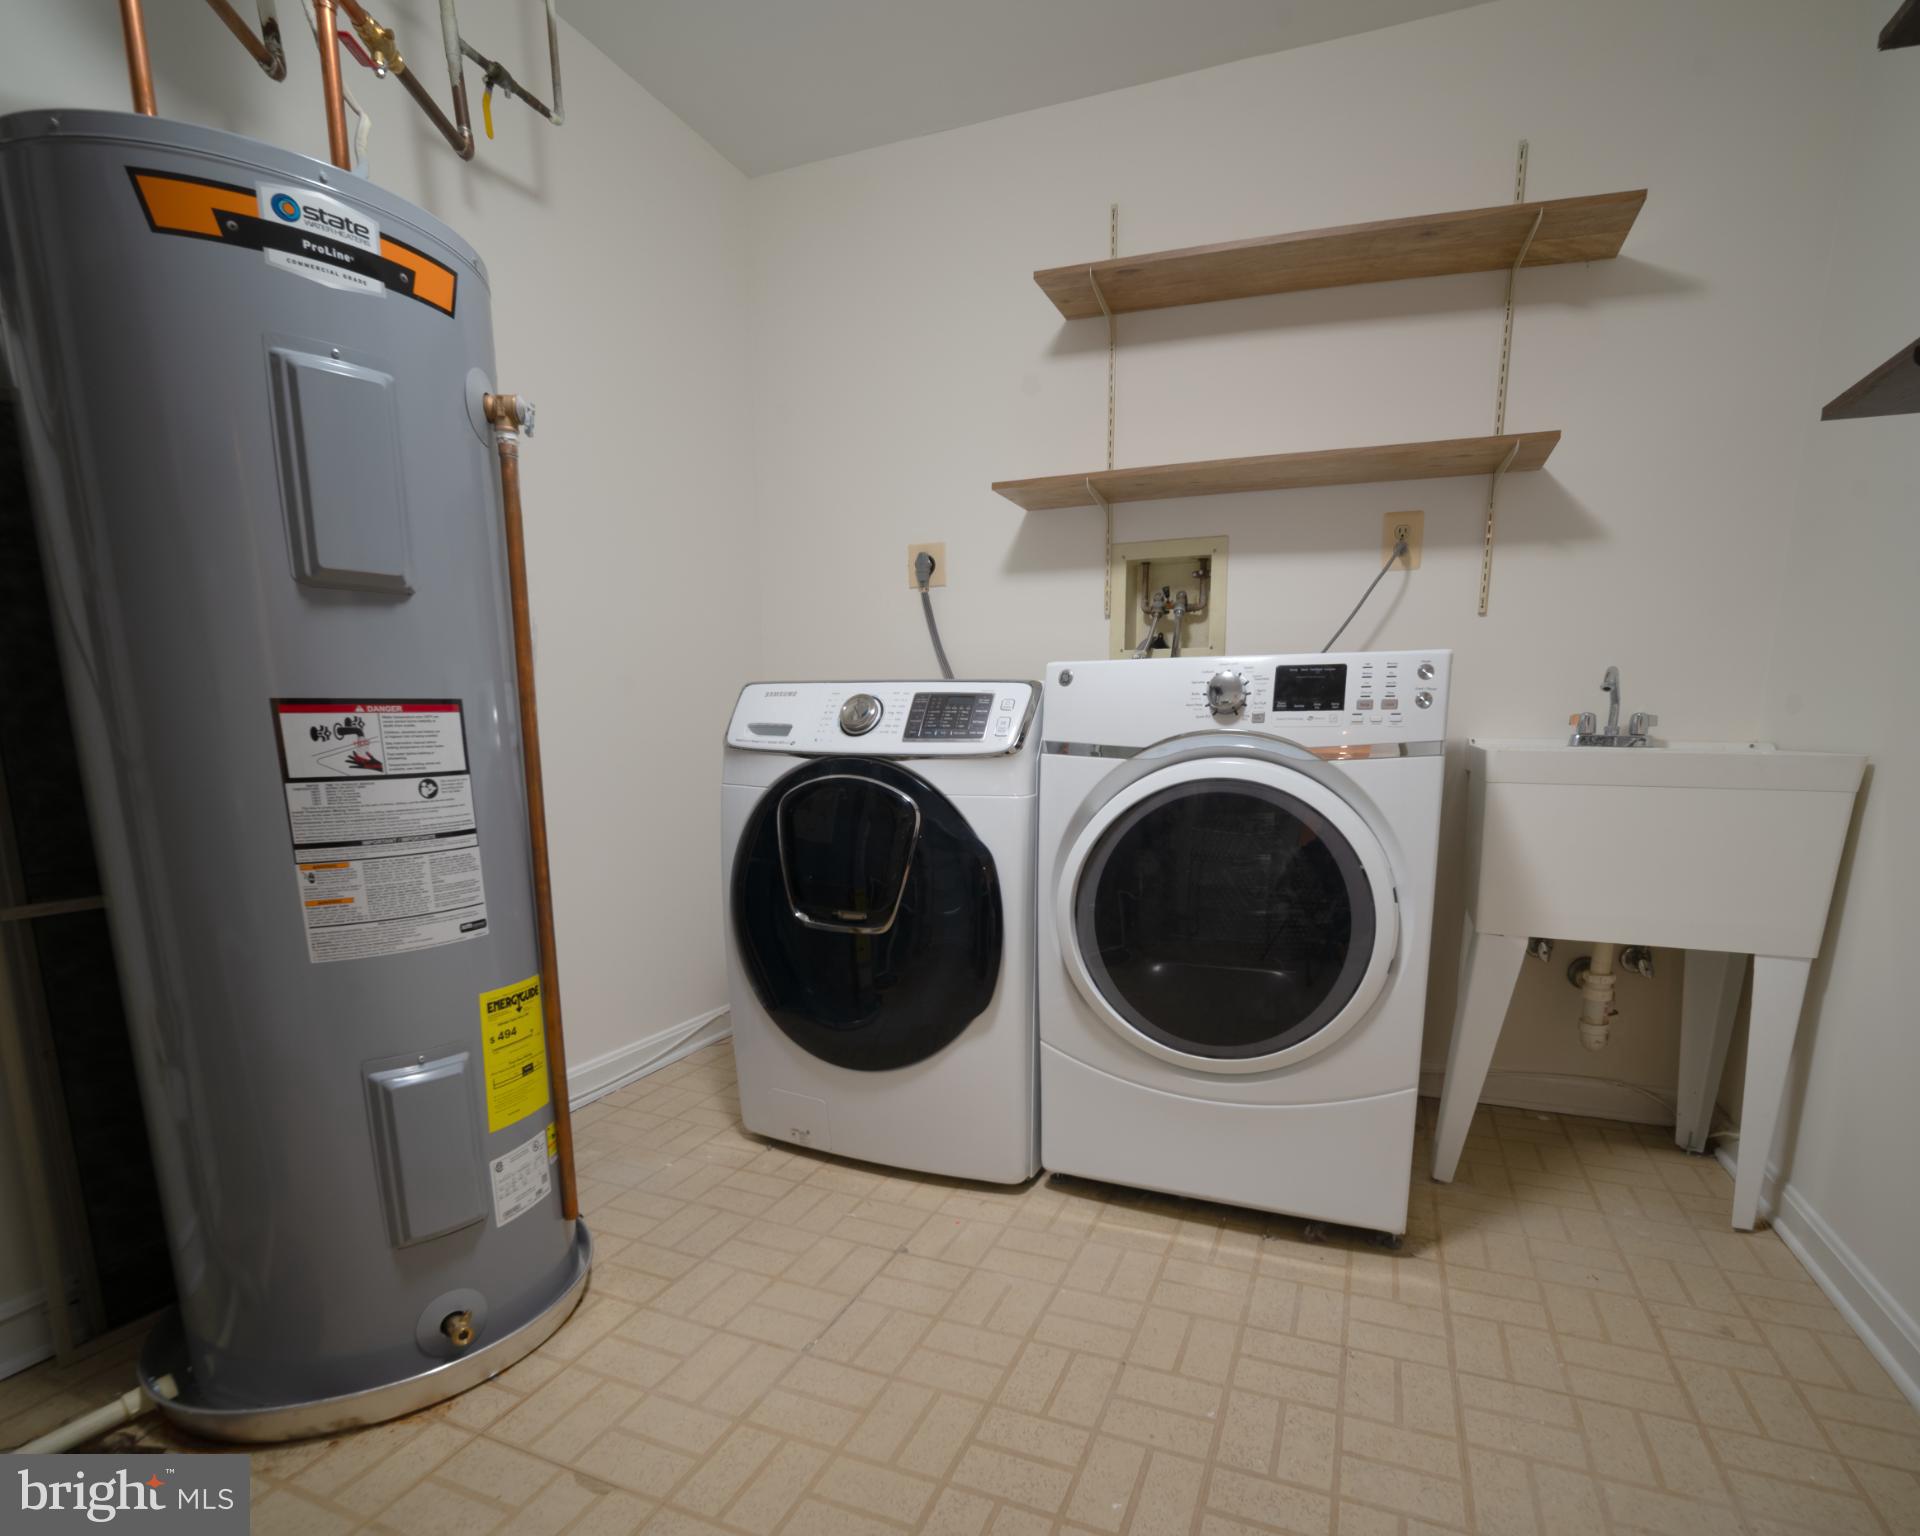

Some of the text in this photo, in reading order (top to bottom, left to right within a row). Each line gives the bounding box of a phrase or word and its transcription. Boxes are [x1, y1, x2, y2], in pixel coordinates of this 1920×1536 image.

[302, 205, 370, 240] state
[286, 257, 368, 287] COMMERCIAL GRADE
[763, 690, 798, 698] SAMSUNG
[366, 704, 404, 713] DANGER
[486, 984, 540, 1014] ENERGYGUIDE
[497, 1026, 518, 1042] 494
